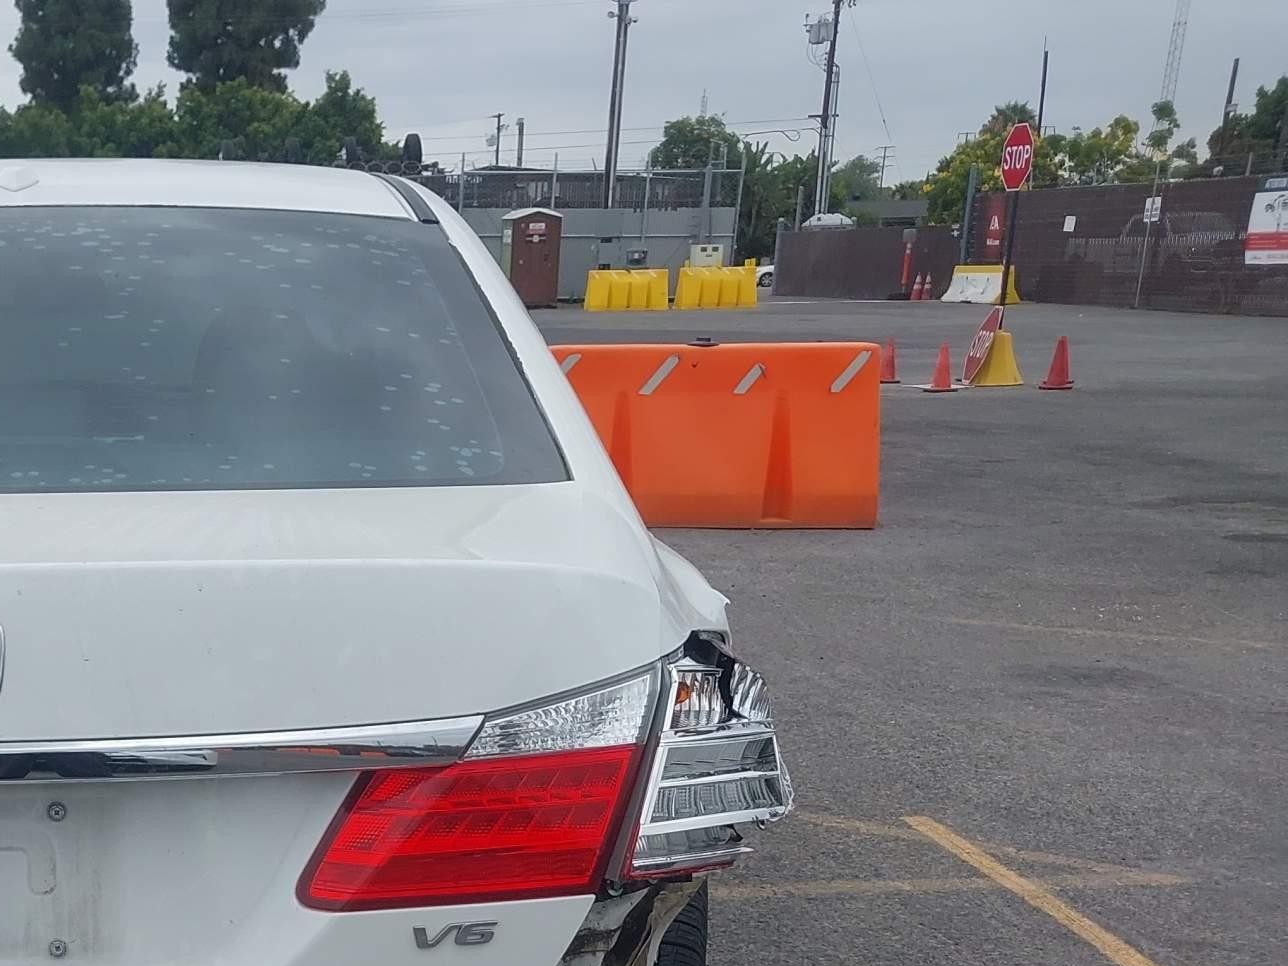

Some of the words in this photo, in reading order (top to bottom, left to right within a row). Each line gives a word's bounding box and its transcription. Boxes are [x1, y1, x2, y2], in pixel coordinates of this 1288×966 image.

[1004, 144, 1031, 170] STOP
[969, 330, 994, 358] STOP
[413, 920, 498, 949] V6
